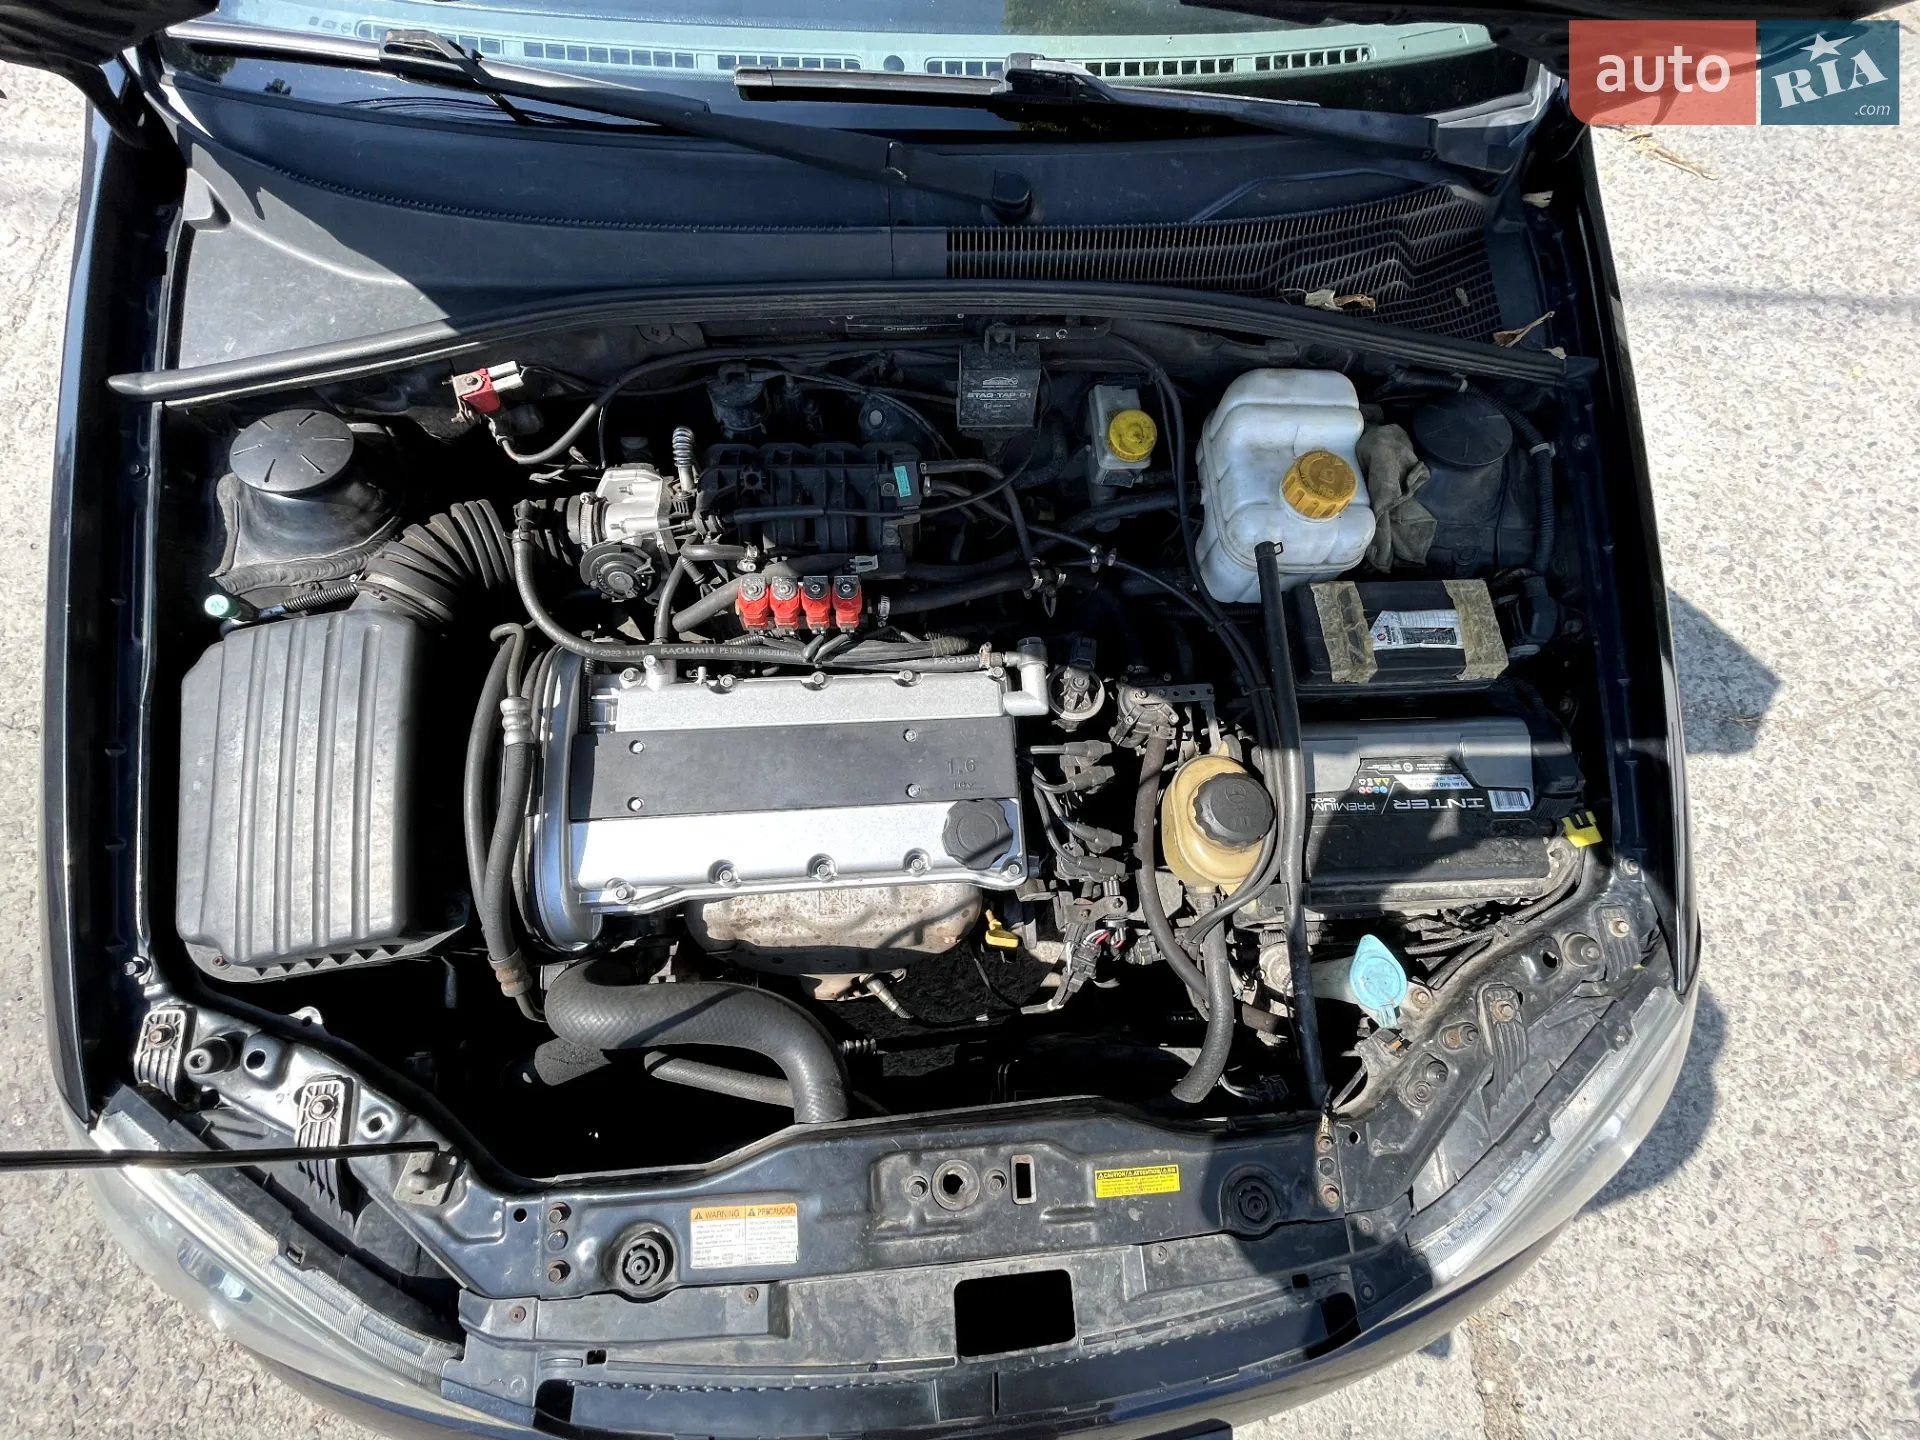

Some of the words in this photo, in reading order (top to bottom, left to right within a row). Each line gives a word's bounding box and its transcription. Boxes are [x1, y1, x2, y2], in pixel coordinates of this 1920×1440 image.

[1311, 801, 1376, 812] PREMIUM
[1393, 797, 1486, 811] INTER
[704, 1209, 741, 1219] WARNING
